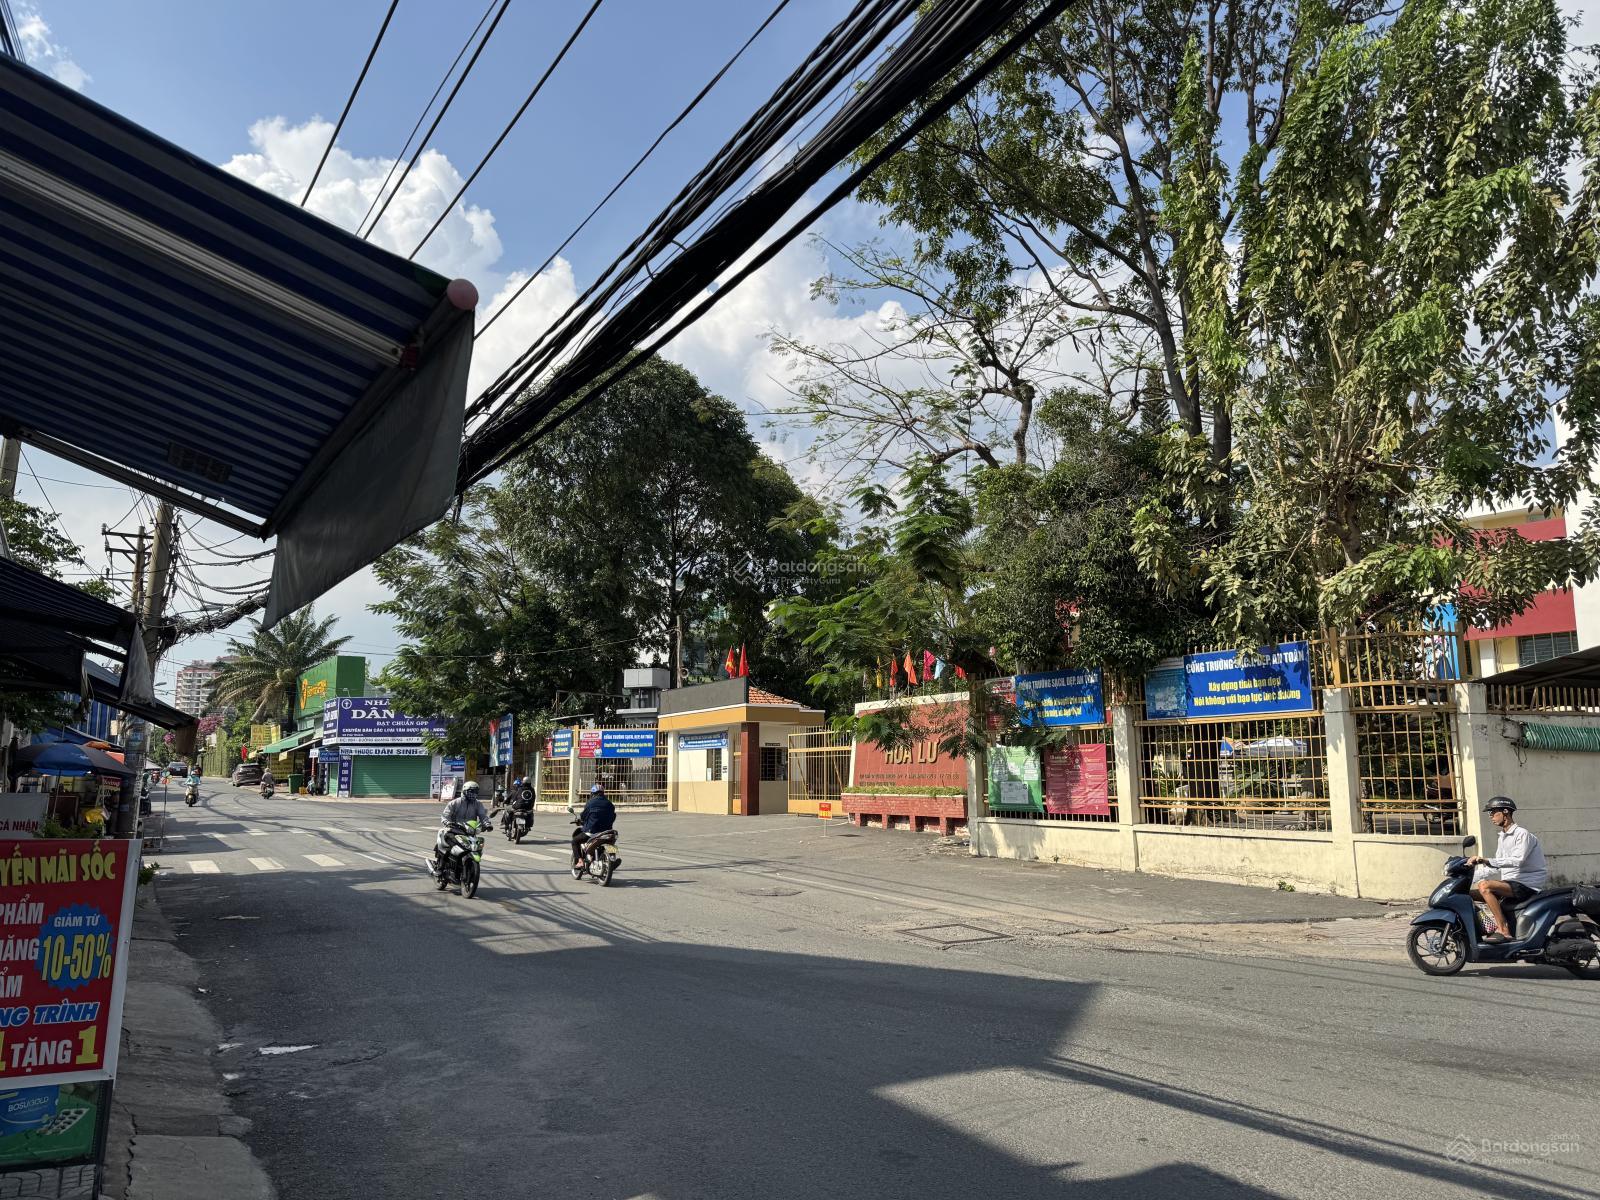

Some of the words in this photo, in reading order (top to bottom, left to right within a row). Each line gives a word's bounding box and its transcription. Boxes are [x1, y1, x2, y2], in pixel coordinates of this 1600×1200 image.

[351, 706, 395, 719] DÂN
[40, 847, 77, 884] MÃI
[81, 842, 116, 881] SỐC
[54, 915, 82, 928] GIẢM
[84, 913, 100, 928] TỪ
[0, 934, 39, 961] ĂNG
[41, 931, 112, 982] 10-50%
[34, 998, 100, 1025] TRÌNH
[11, 1037, 72, 1073] TẶNG
[76, 1025, 99, 1065] 1
